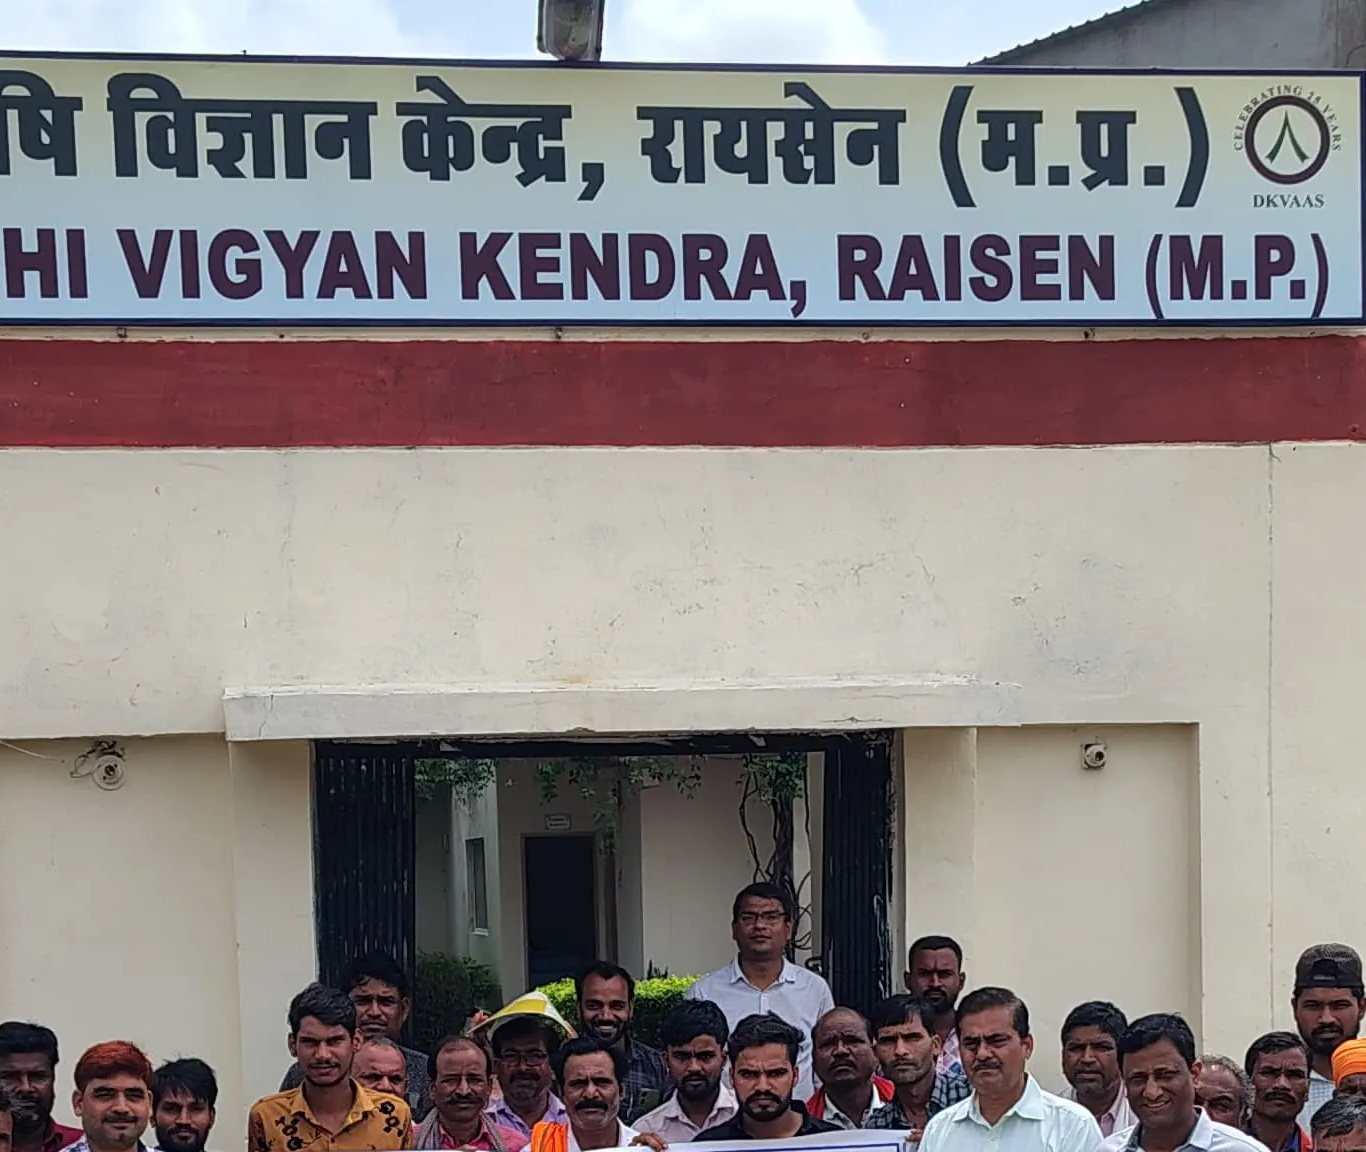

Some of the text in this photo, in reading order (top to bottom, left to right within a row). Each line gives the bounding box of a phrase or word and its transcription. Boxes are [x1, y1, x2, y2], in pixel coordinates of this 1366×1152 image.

[107, 72, 378, 179] विज्ञान
[637, 82, 906, 186] रायसेन
[939, 86, 1209, 208] (म.प्र.)
[1234, 84, 1303, 151] CELEBRATING
[1323, 104, 1341, 151] YEARS
[1253, 194, 1325, 208] DKVAAS
[116, 228, 427, 300] VIGYAN
[460, 231, 807, 316] KENDRA,
[838, 234, 1115, 302] RAISEN
[1145, 233, 1329, 319] (M.P.)
